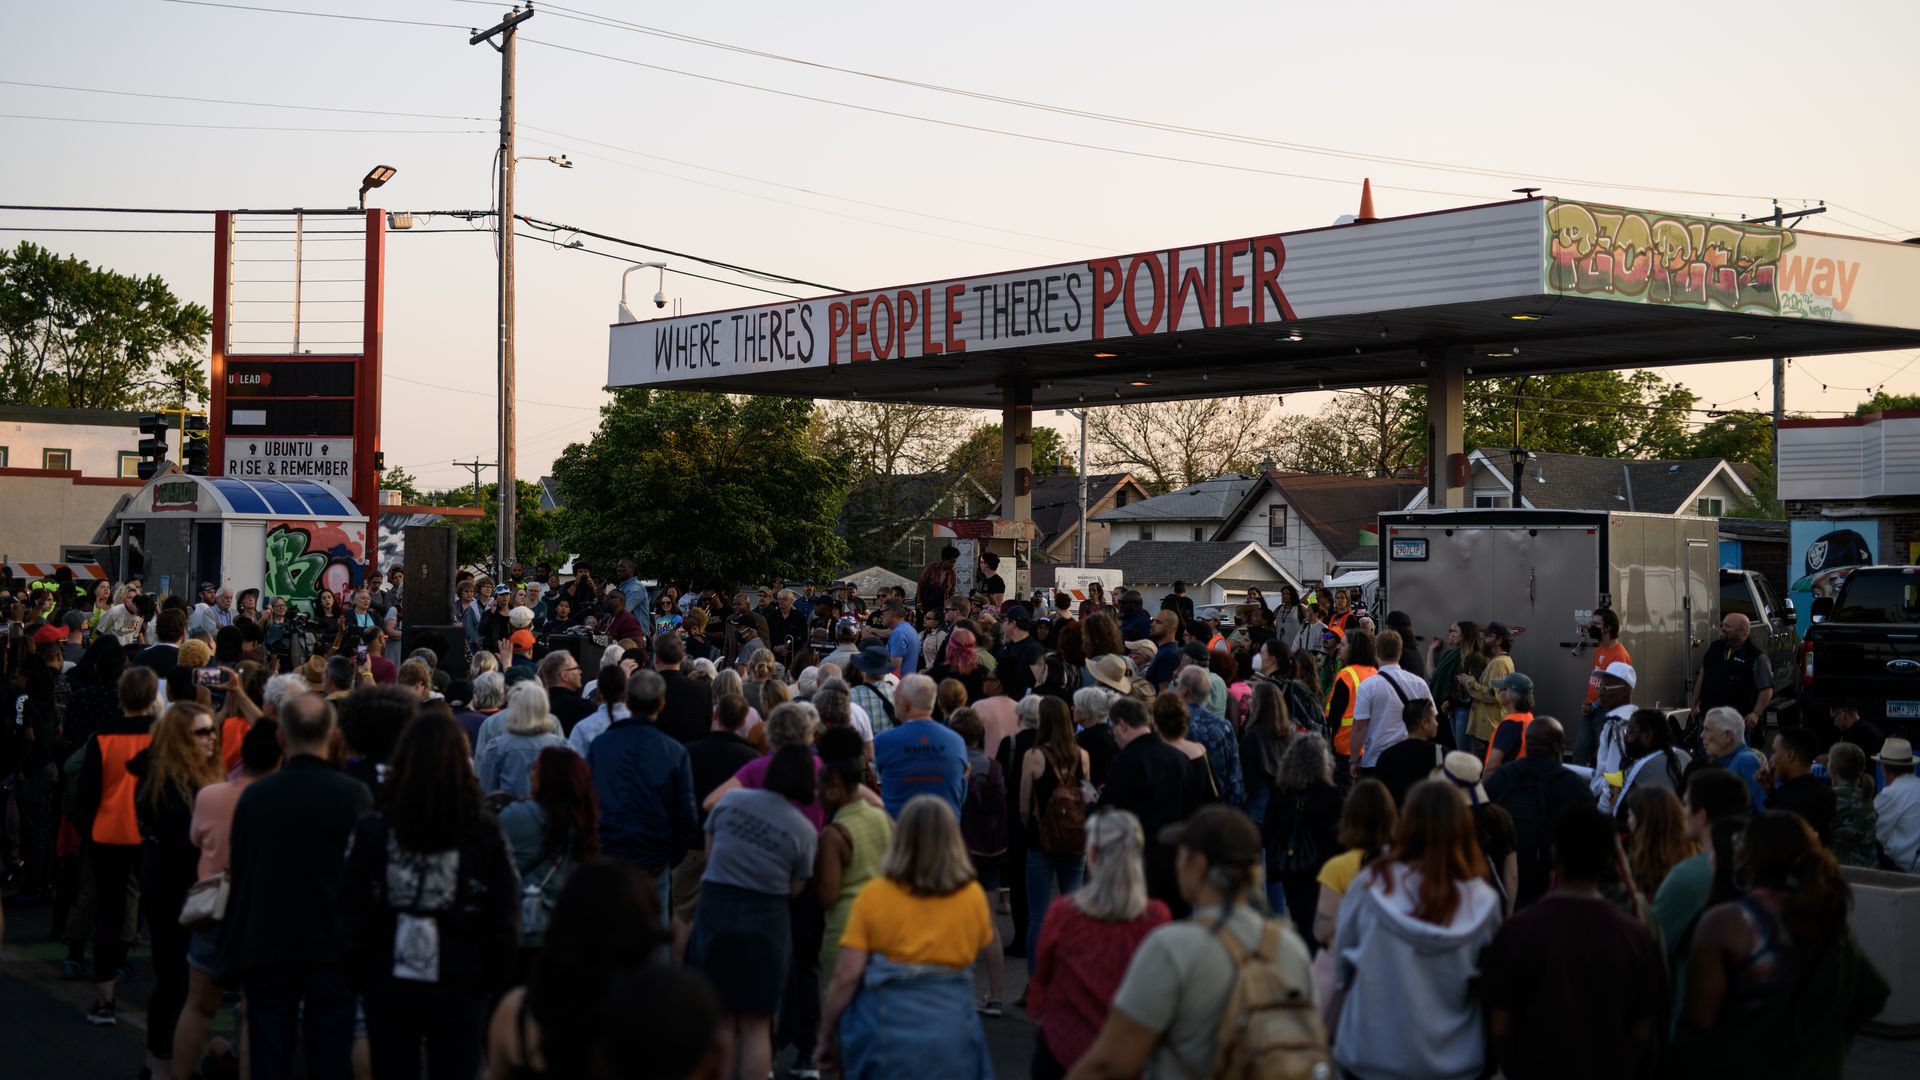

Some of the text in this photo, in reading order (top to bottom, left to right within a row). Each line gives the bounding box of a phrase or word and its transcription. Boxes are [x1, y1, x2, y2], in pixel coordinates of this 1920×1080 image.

[1779, 254, 1860, 311] way
[655, 236, 1298, 372] WHERE THERE'S PEOPLE THERE'S POWER
[264, 442, 313, 457] UBUNTU
[229, 460, 348, 476] RISE & REMEMBER
[1460, 465, 1466, 477] 1
